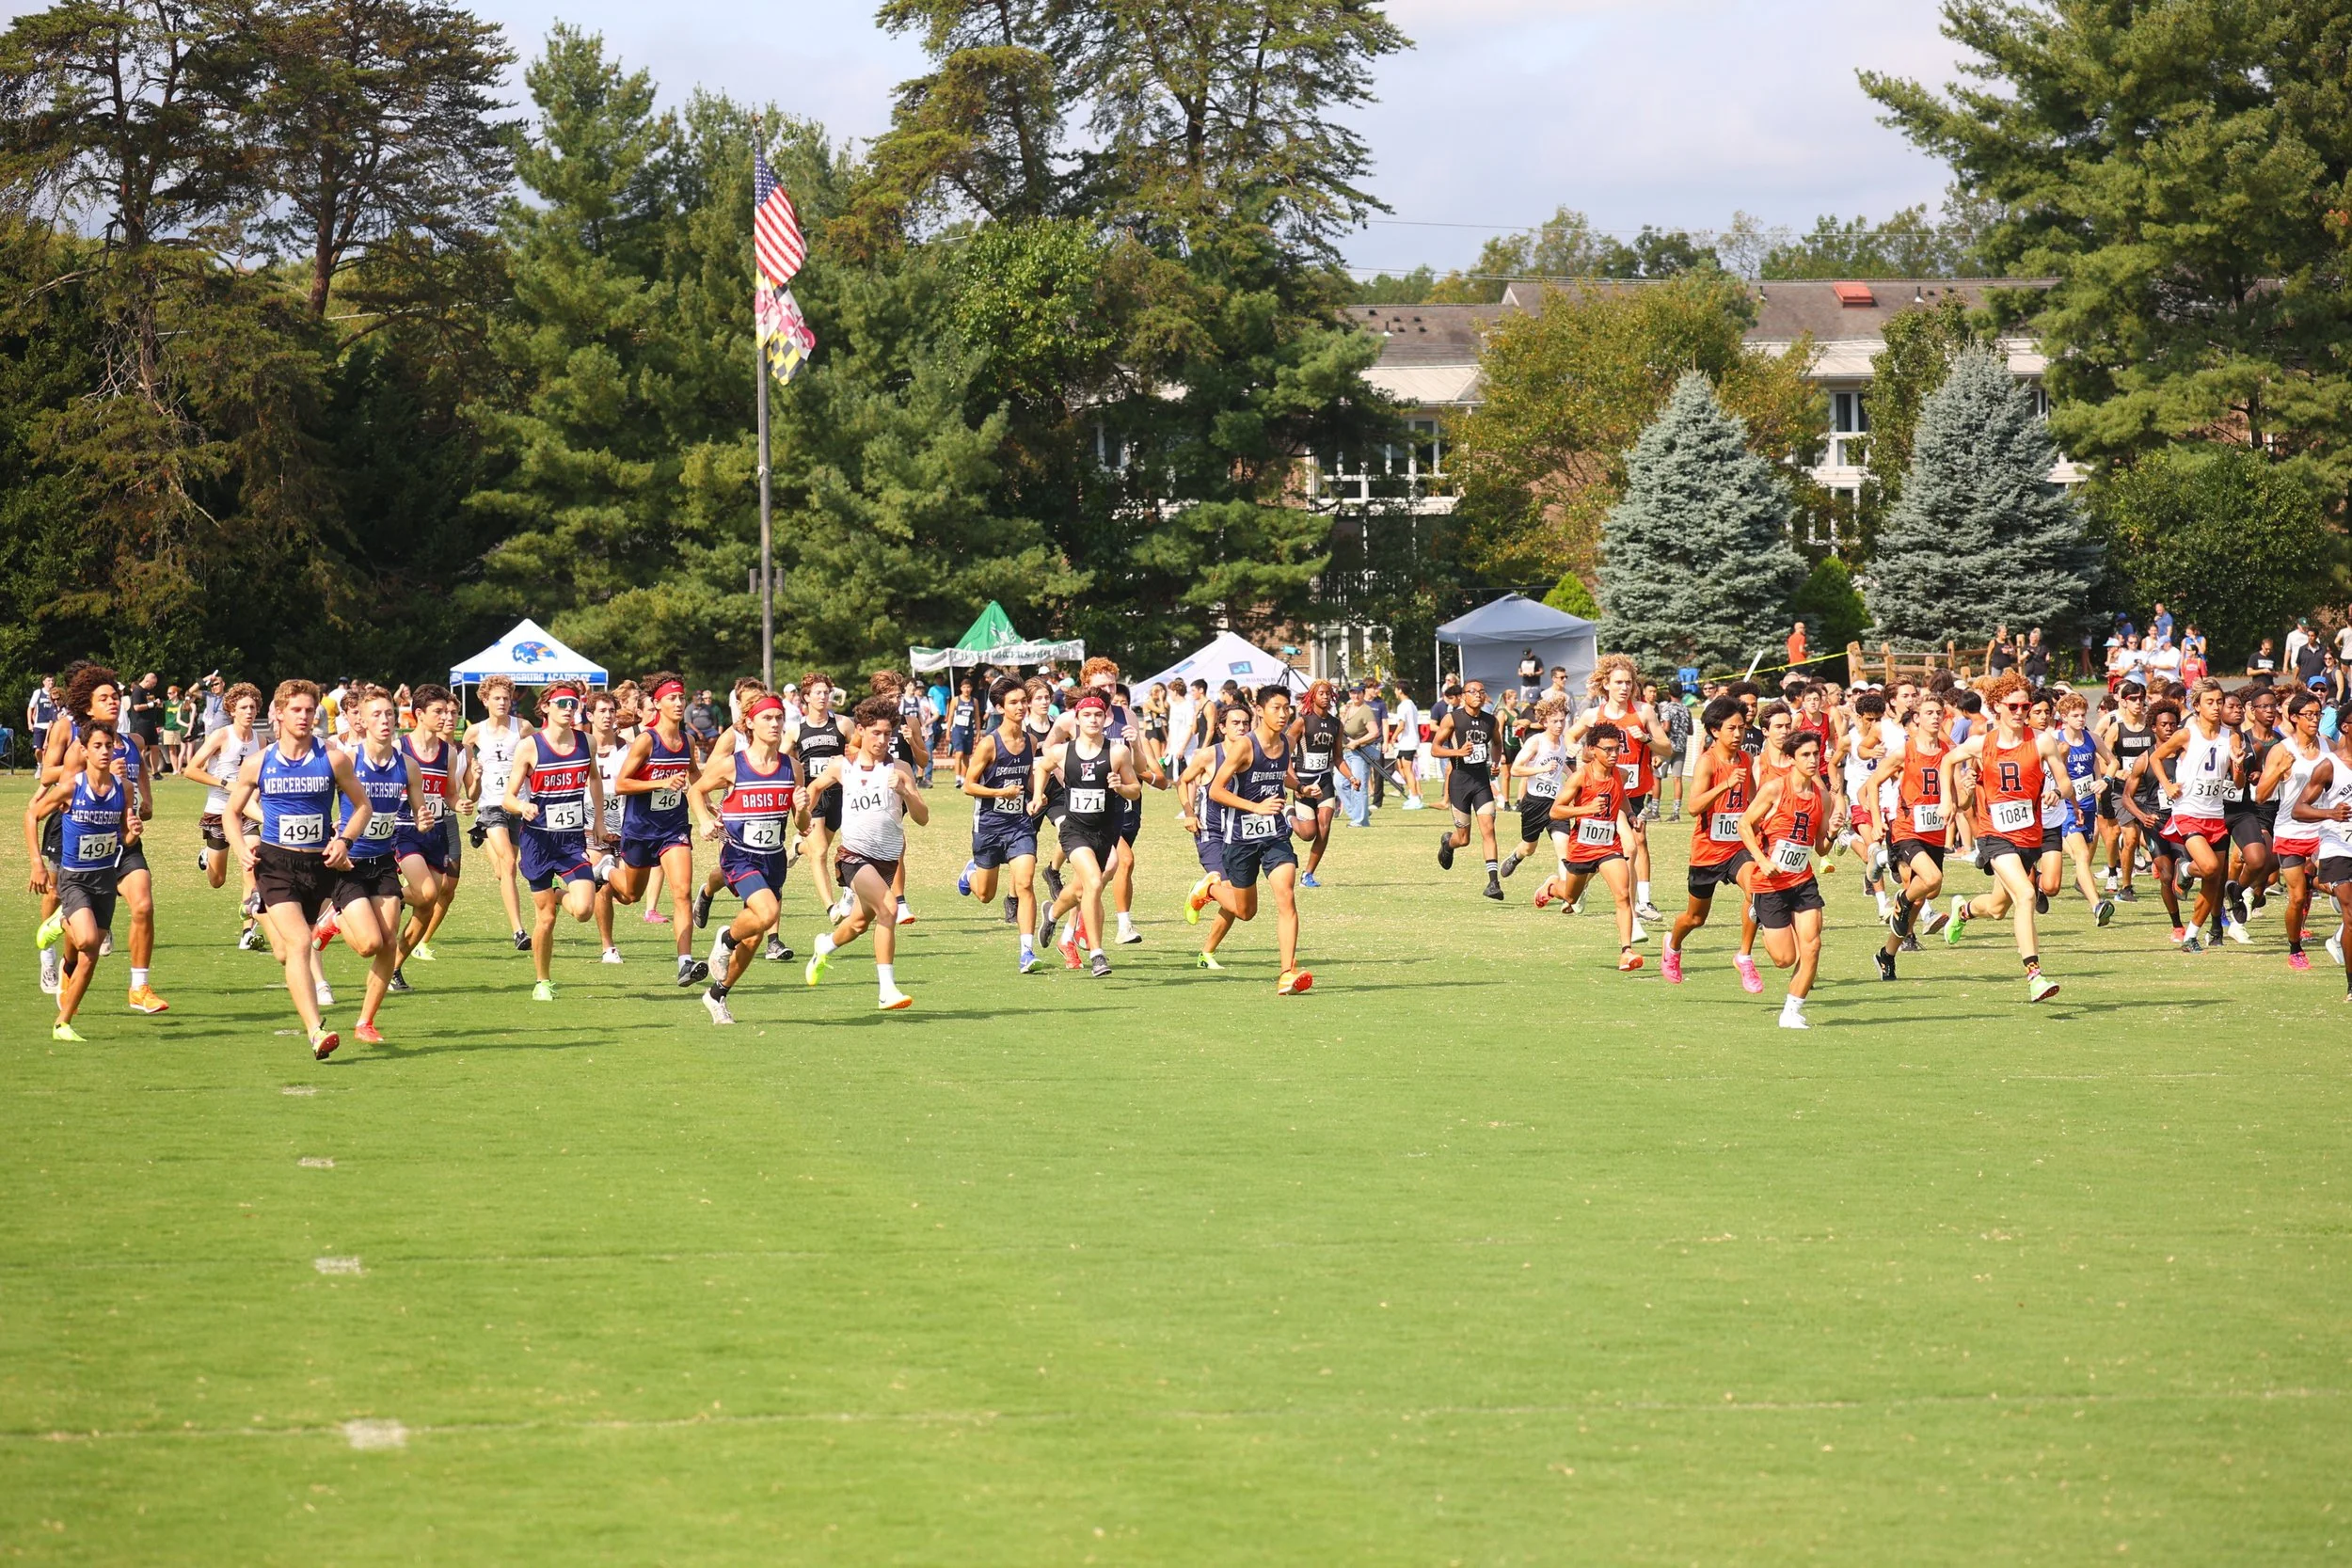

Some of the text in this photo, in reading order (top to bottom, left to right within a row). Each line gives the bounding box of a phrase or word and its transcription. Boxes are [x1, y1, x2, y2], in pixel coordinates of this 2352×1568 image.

[480, 673, 545, 683] MRSBURG
[2204, 747, 2217, 771] J
[544, 770, 587, 787] BASIS DC
[1080, 762, 1096, 781] E
[1998, 761, 2023, 792] R
[263, 776, 329, 794] MERCERSBURG
[1535, 782, 1558, 797] 695
[2196, 783, 2220, 797] 318
[659, 794, 676, 807] 46
[742, 793, 789, 808] BASIS DC
[2222, 786, 2235, 800] 76
[850, 793, 882, 812] 404
[996, 798, 1022, 811] 263
[1074, 797, 1102, 810] 171
[555, 811, 575, 825] 45
[1998, 806, 2029, 826] 1084
[283, 823, 321, 841] 494
[368, 821, 394, 836] 503
[1245, 820, 1274, 836] 261
[1585, 826, 1611, 840] 1071
[1718, 820, 1739, 835] 109
[1788, 811, 1810, 843] R
[753, 831, 773, 845] 42
[83, 842, 113, 858] 491
[1779, 848, 1806, 867] 1087
